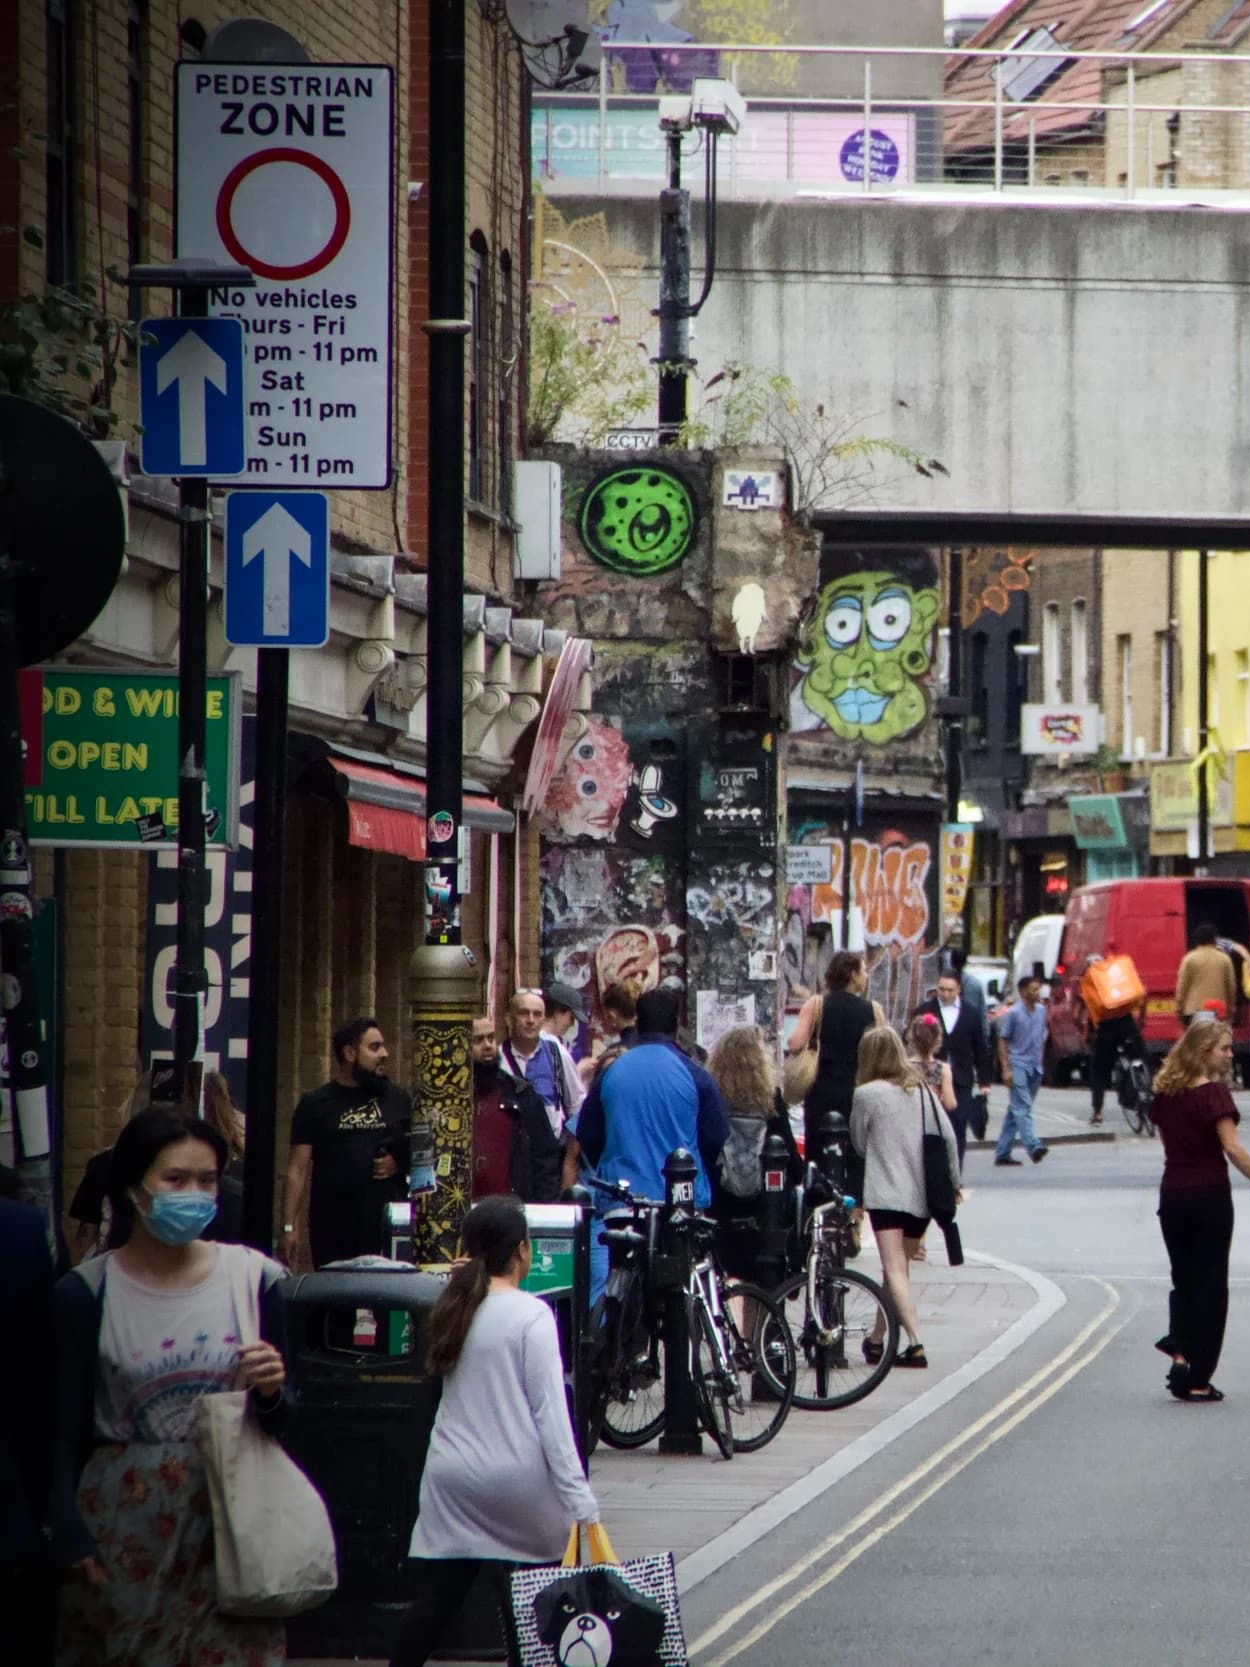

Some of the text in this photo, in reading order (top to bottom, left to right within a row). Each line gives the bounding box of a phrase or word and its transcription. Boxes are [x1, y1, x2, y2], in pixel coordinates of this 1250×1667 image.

[196, 74, 373, 98] PEDESTRIAN
[220, 102, 346, 137] ZONE
[210, 287, 358, 309] No vehicles
[314, 315, 345, 336] Fri
[254, 345, 291, 364] pm
[313, 342, 333, 361] 11
[340, 347, 378, 365] pm
[261, 370, 305, 391] Sat
[292, 398, 312, 417] 11
[319, 403, 357, 421] pm
[258, 427, 306, 447] Sun
[607, 434, 652, 448] CCTV
[290, 454, 310, 473] 11
[317, 458, 354, 477] pm
[92, 687, 117, 717] &
[125, 688, 224, 719] WIE
[48, 740, 148, 771] OPEN
[96, 796, 179, 826] LATE
